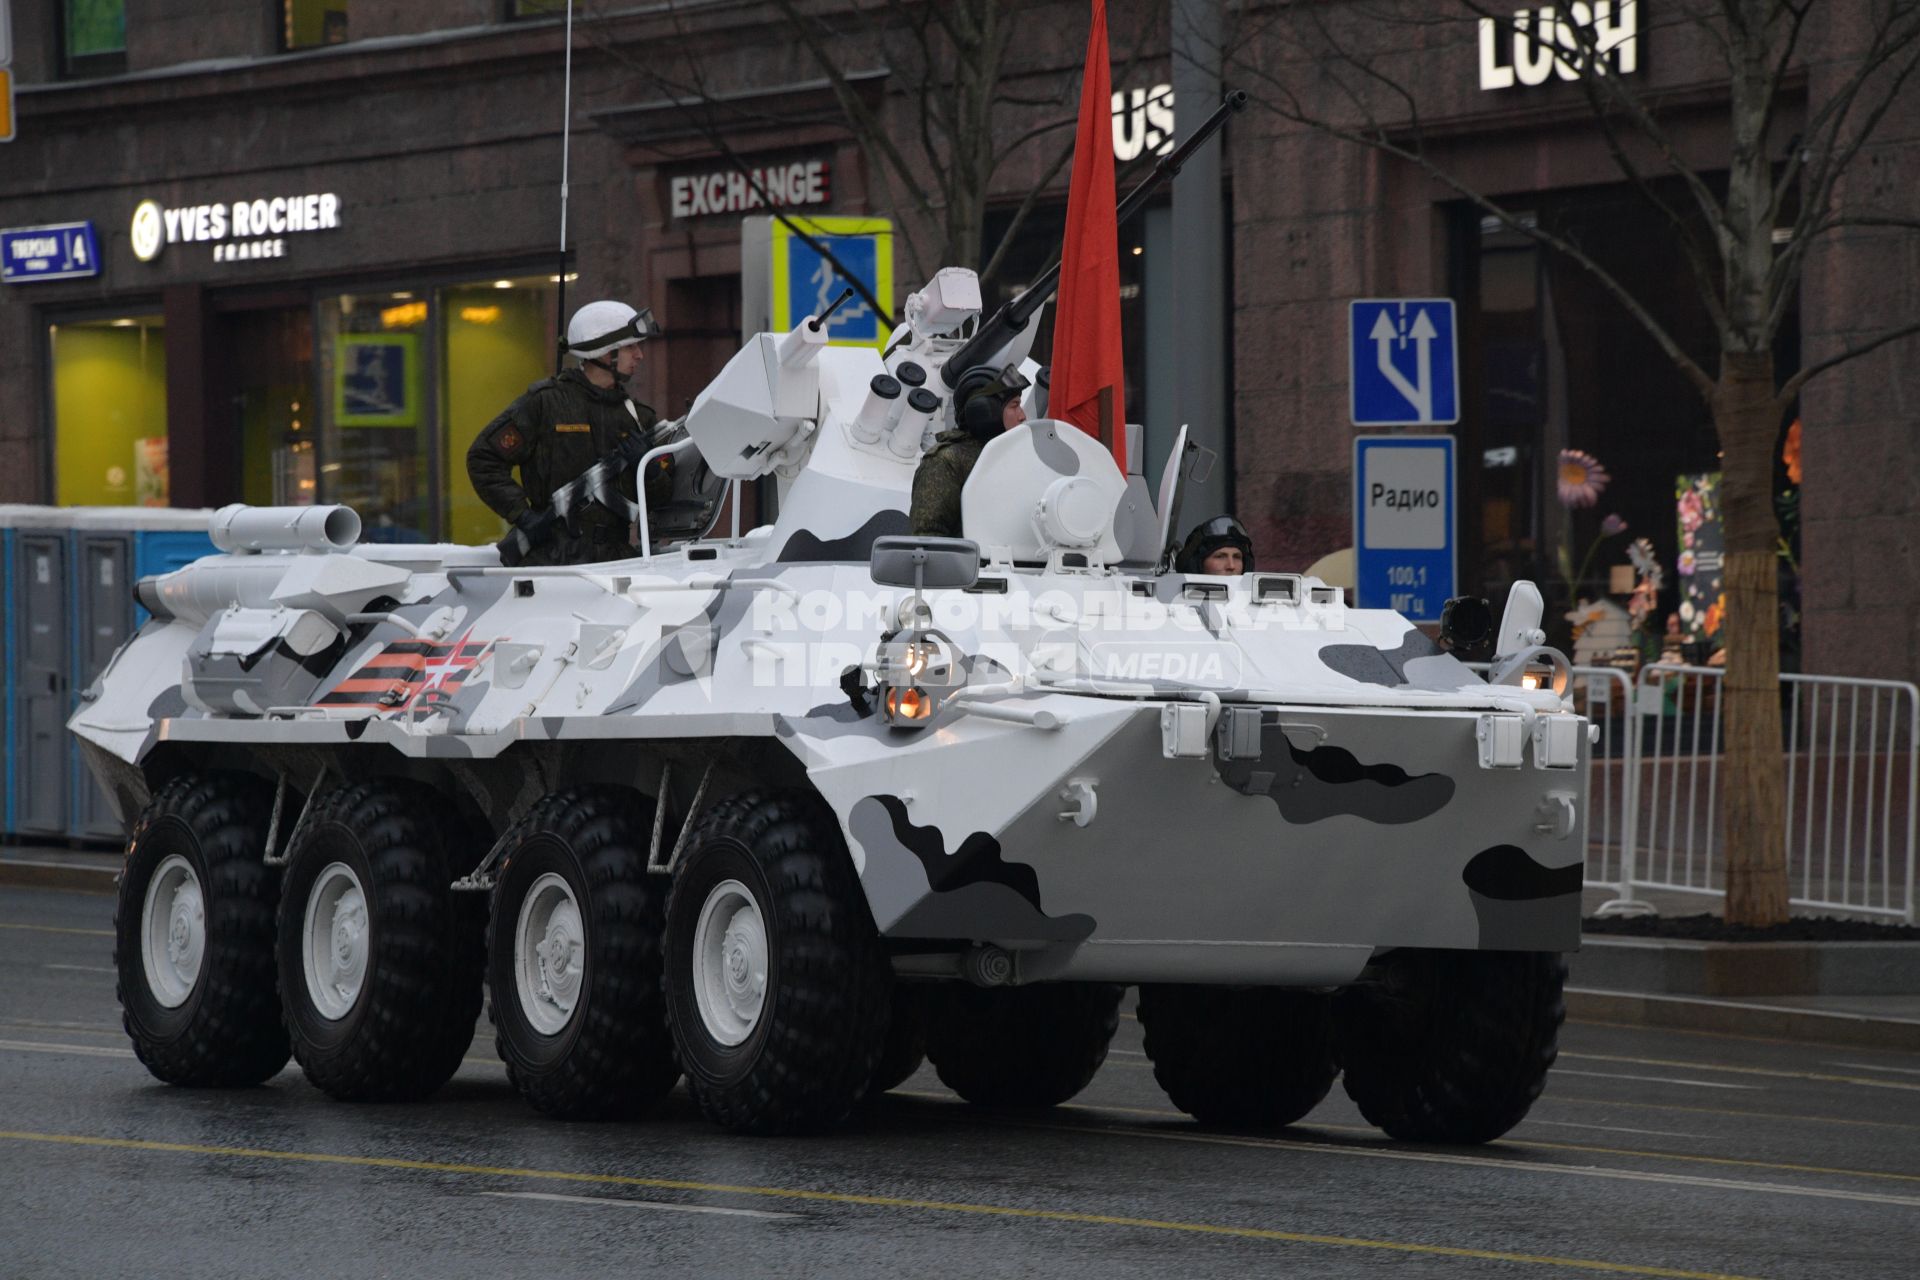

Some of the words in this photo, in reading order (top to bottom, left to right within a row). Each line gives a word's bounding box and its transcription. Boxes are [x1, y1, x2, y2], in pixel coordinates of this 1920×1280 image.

[672, 160, 826, 219] EXCHANGE
[164, 203, 228, 244] YVES
[232, 193, 338, 238] ROCHER
[73, 234, 87, 266] 4
[213, 239, 285, 263] FRANCE
[1371, 482, 1440, 512] Радио
[1387, 566, 1427, 588] 100,1
[1390, 593, 1426, 616] МГц
